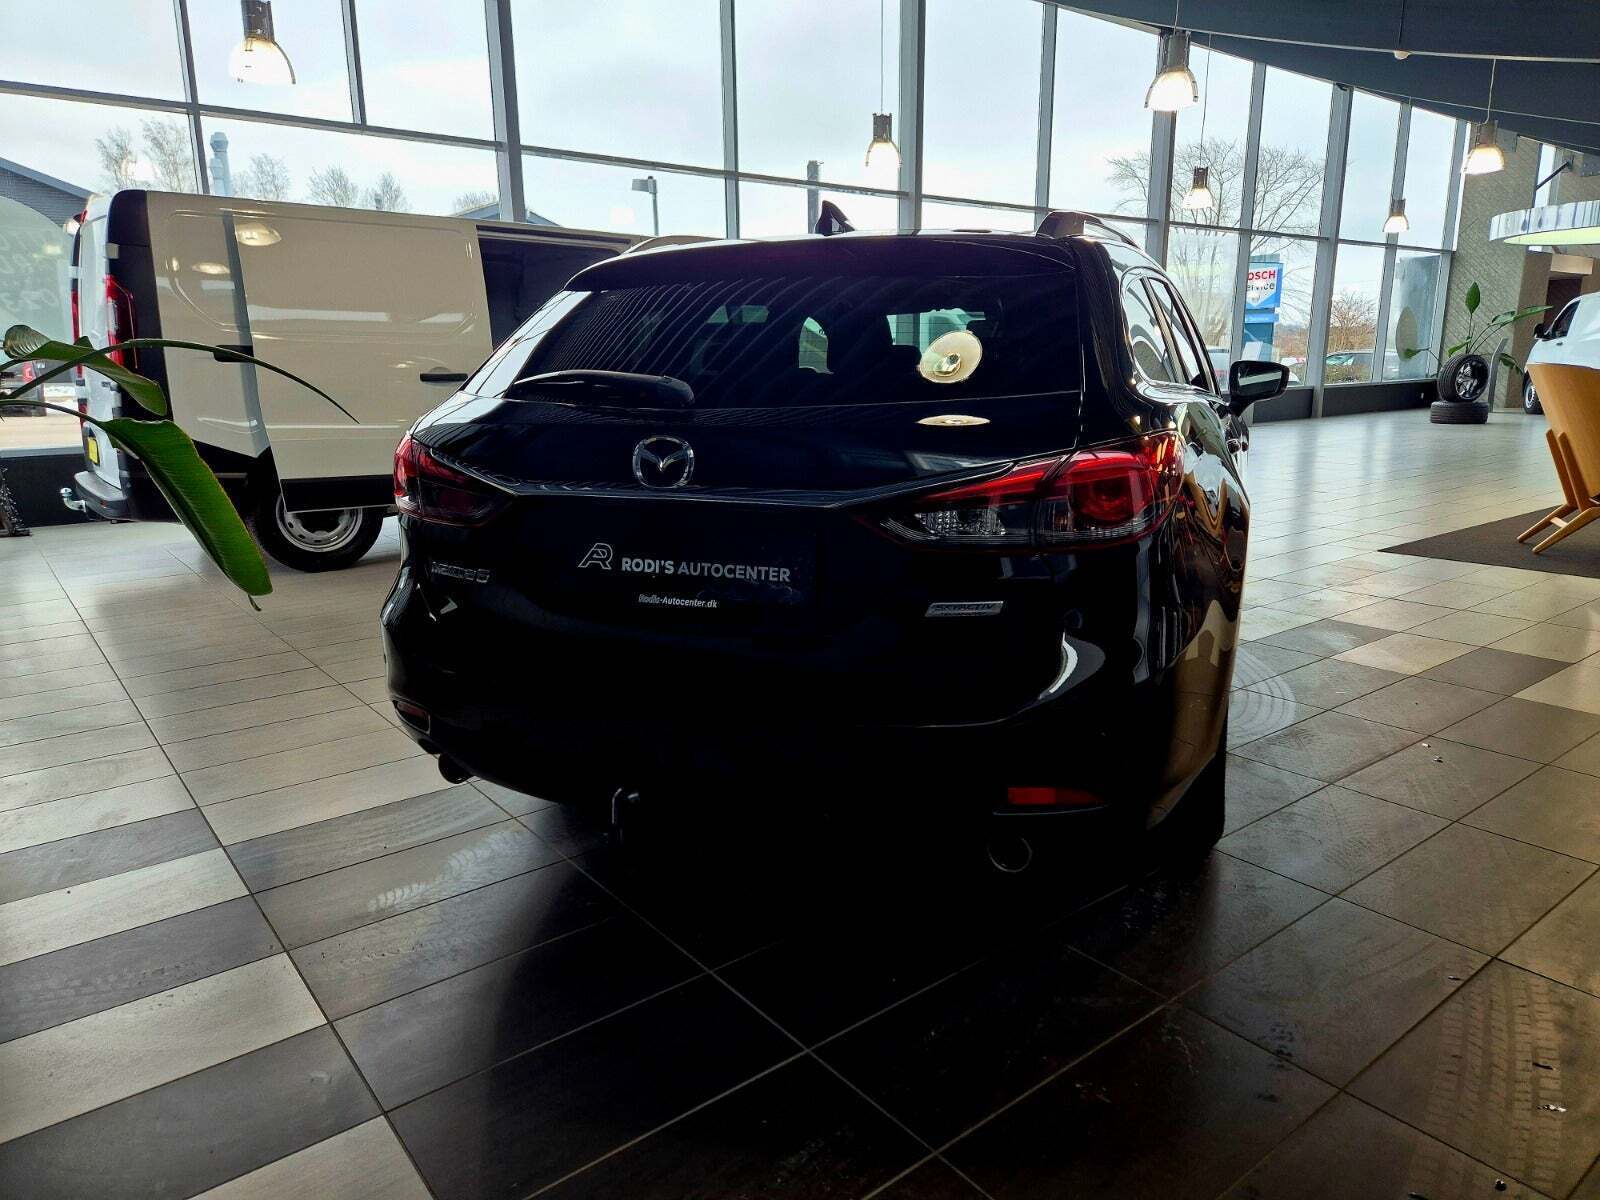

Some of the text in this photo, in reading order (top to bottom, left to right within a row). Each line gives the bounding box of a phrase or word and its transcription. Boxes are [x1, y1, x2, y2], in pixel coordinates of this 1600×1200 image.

[1248, 270, 1276, 281] OSCH
[1247, 283, 1275, 291] ervice
[621, 557, 791, 583] RODI'S AUTOCENTER
